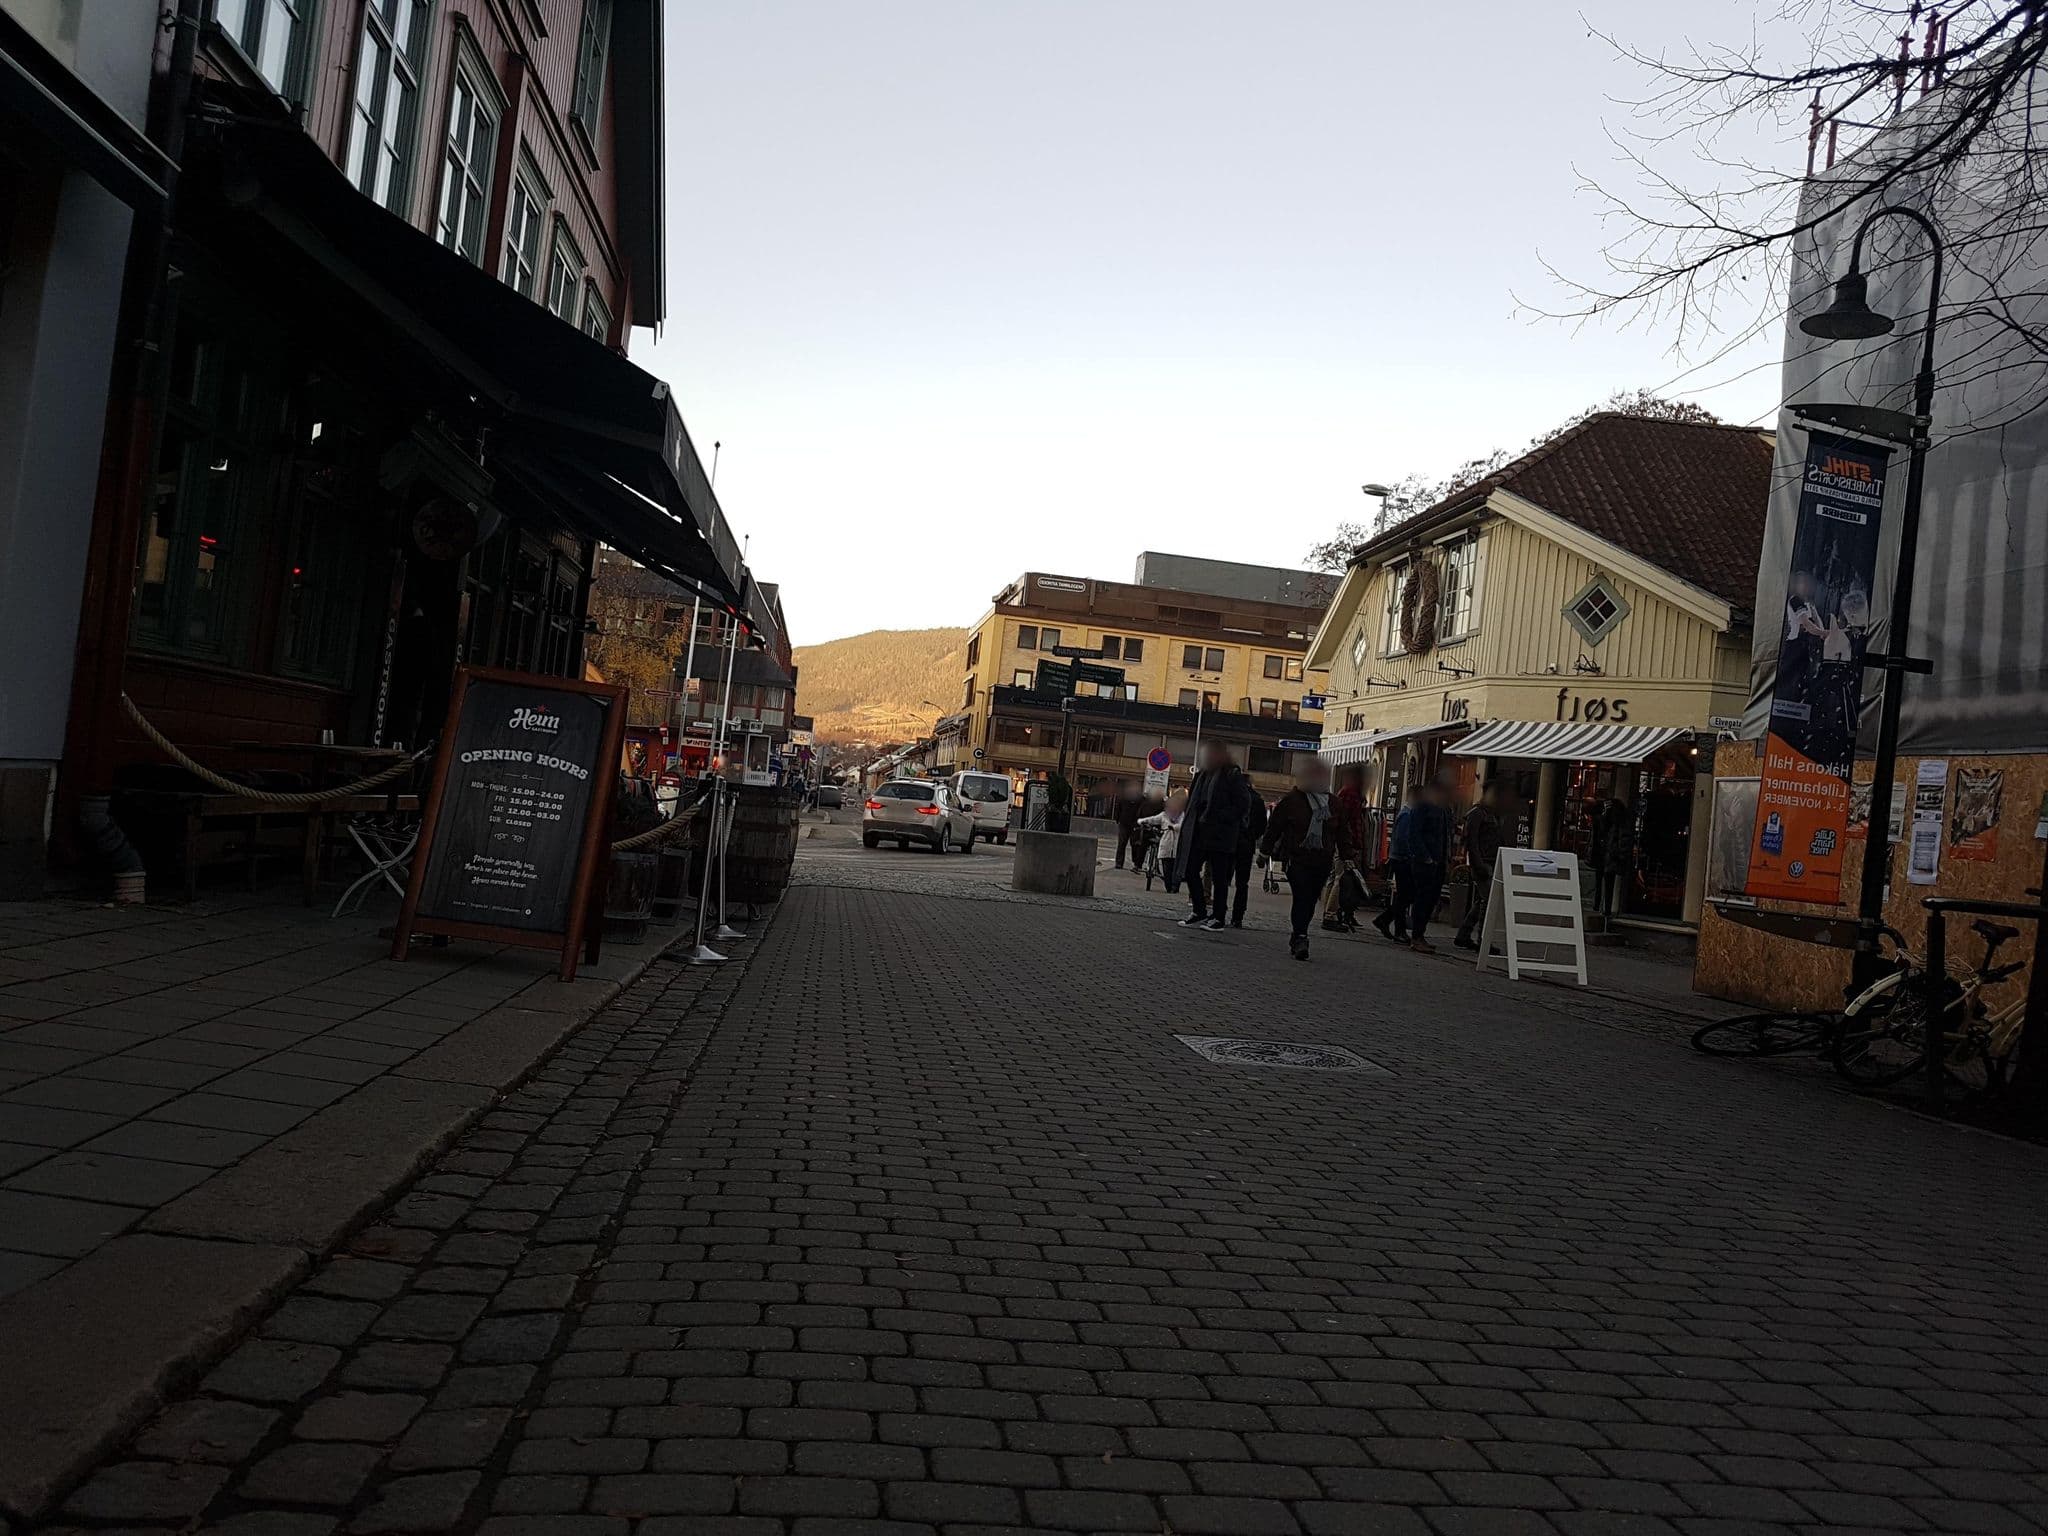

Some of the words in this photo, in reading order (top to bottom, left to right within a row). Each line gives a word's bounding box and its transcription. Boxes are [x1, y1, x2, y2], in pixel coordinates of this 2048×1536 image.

[373, 617, 395, 746] GASTROPU
[508, 708, 560, 730] Heim
[1441, 691, 1469, 721] fjøs
[1557, 687, 1628, 722] fjøs
[460, 749, 533, 763] OPENING
[536, 753, 589, 781] HOURS
[505, 818, 532, 827] CLOSED
